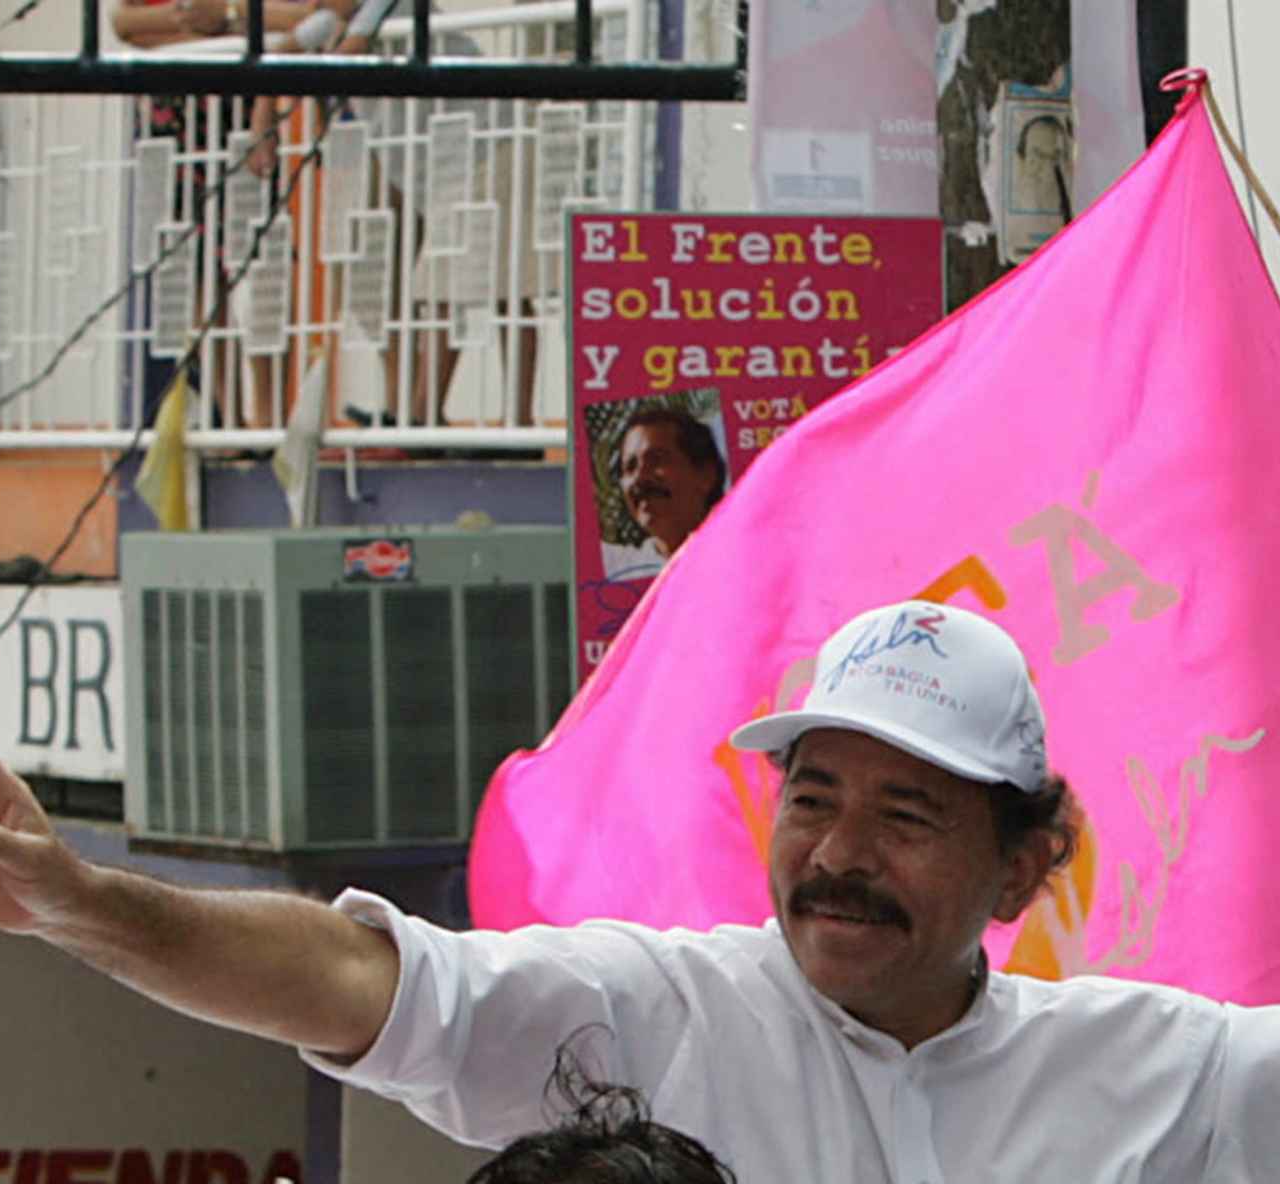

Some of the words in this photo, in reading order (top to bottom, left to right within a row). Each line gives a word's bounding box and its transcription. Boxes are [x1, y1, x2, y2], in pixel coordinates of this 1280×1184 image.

[581, 220, 648, 263] El
[671, 222, 882, 270] Frente,
[581, 276, 860, 320] solución
[583, 345, 619, 390] y
[643, 335, 904, 390] garantí
